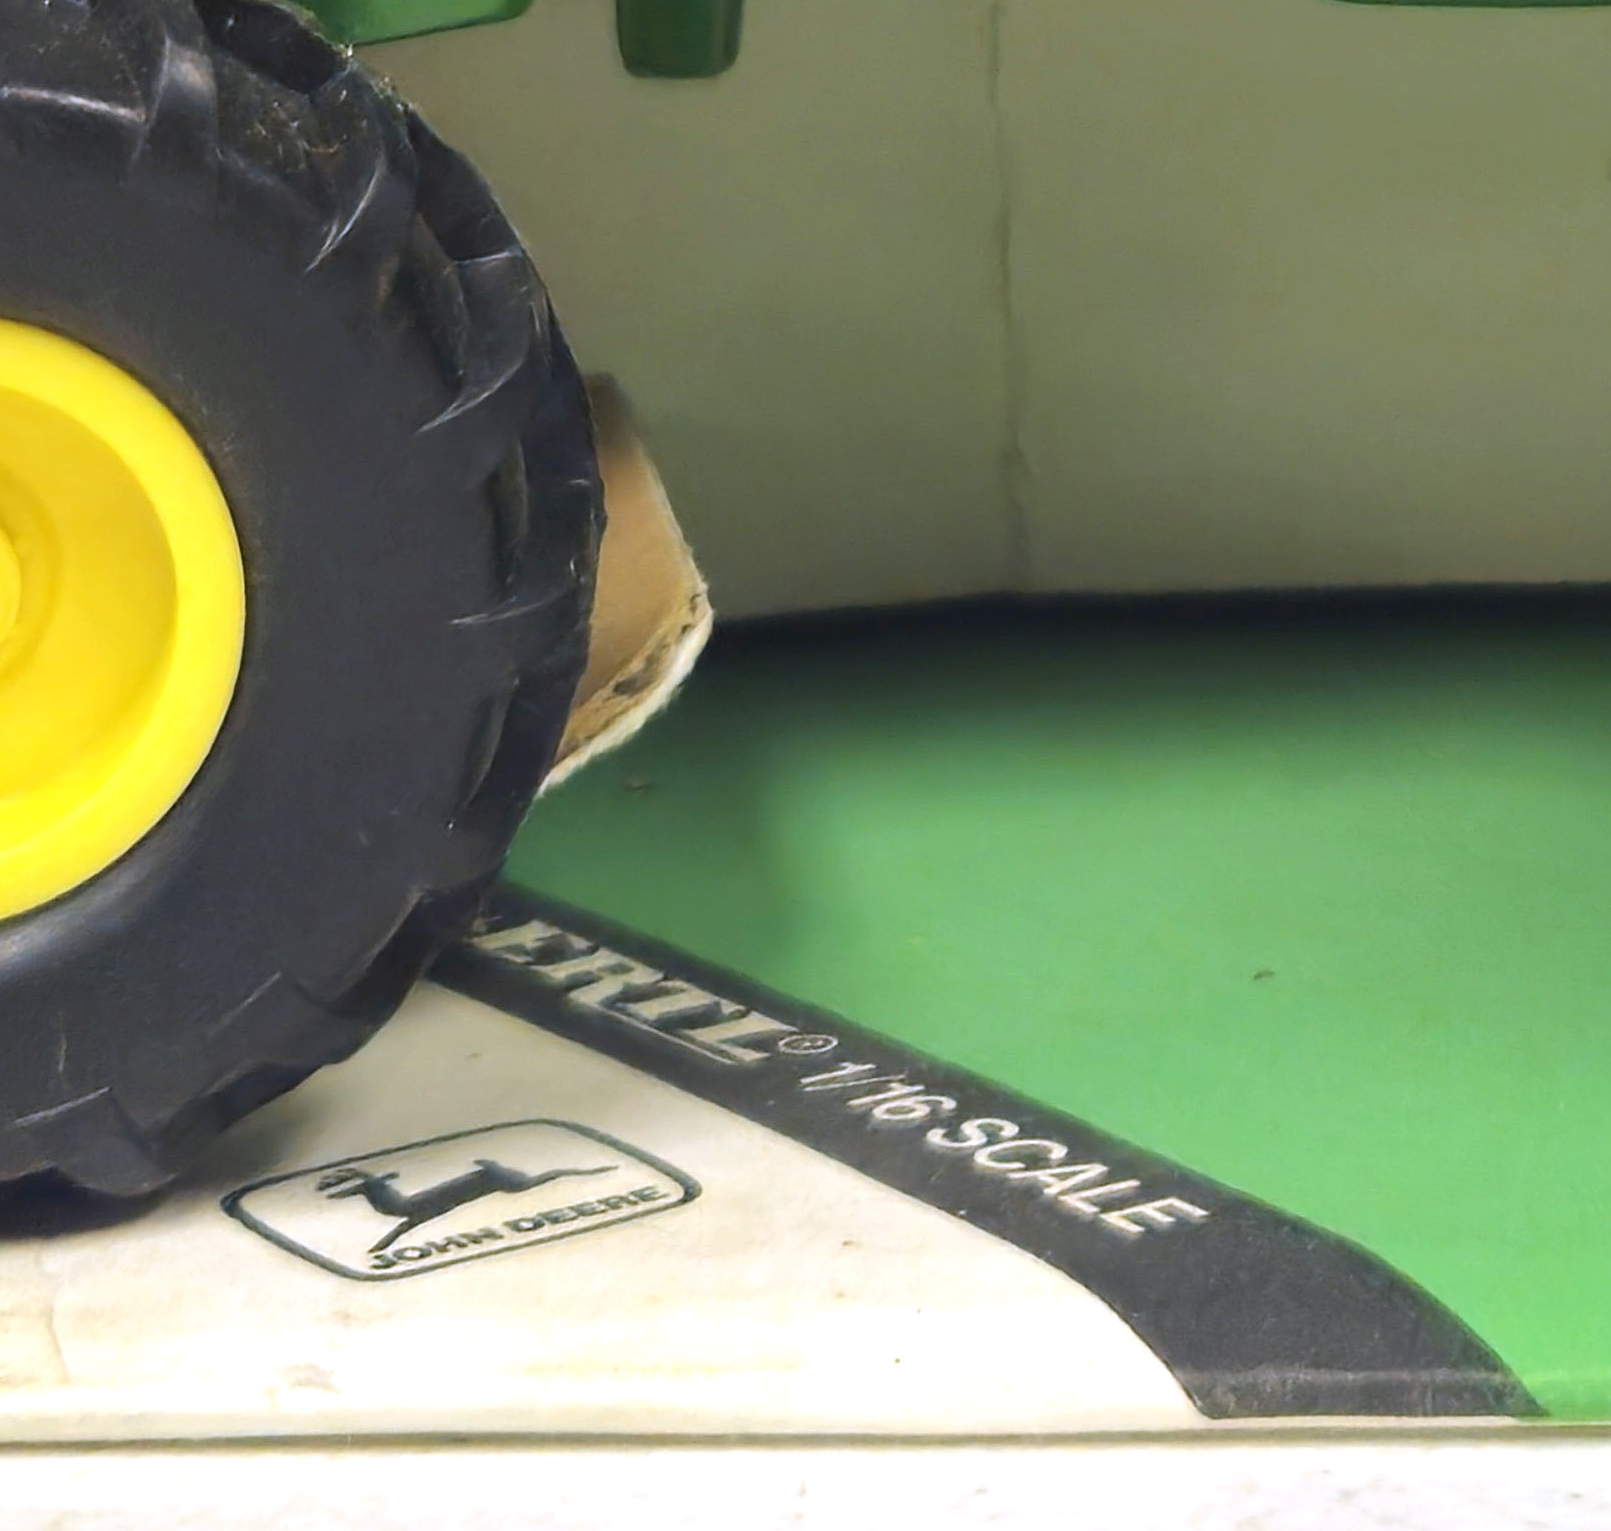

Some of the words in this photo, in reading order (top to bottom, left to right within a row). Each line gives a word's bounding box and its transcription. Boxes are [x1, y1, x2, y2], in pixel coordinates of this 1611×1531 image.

[800, 1060, 958, 1123] 1/16
[927, 1116, 1211, 1235] SCALE
[369, 1226, 504, 1270] JOHN
[502, 1185, 670, 1233] DEERE
